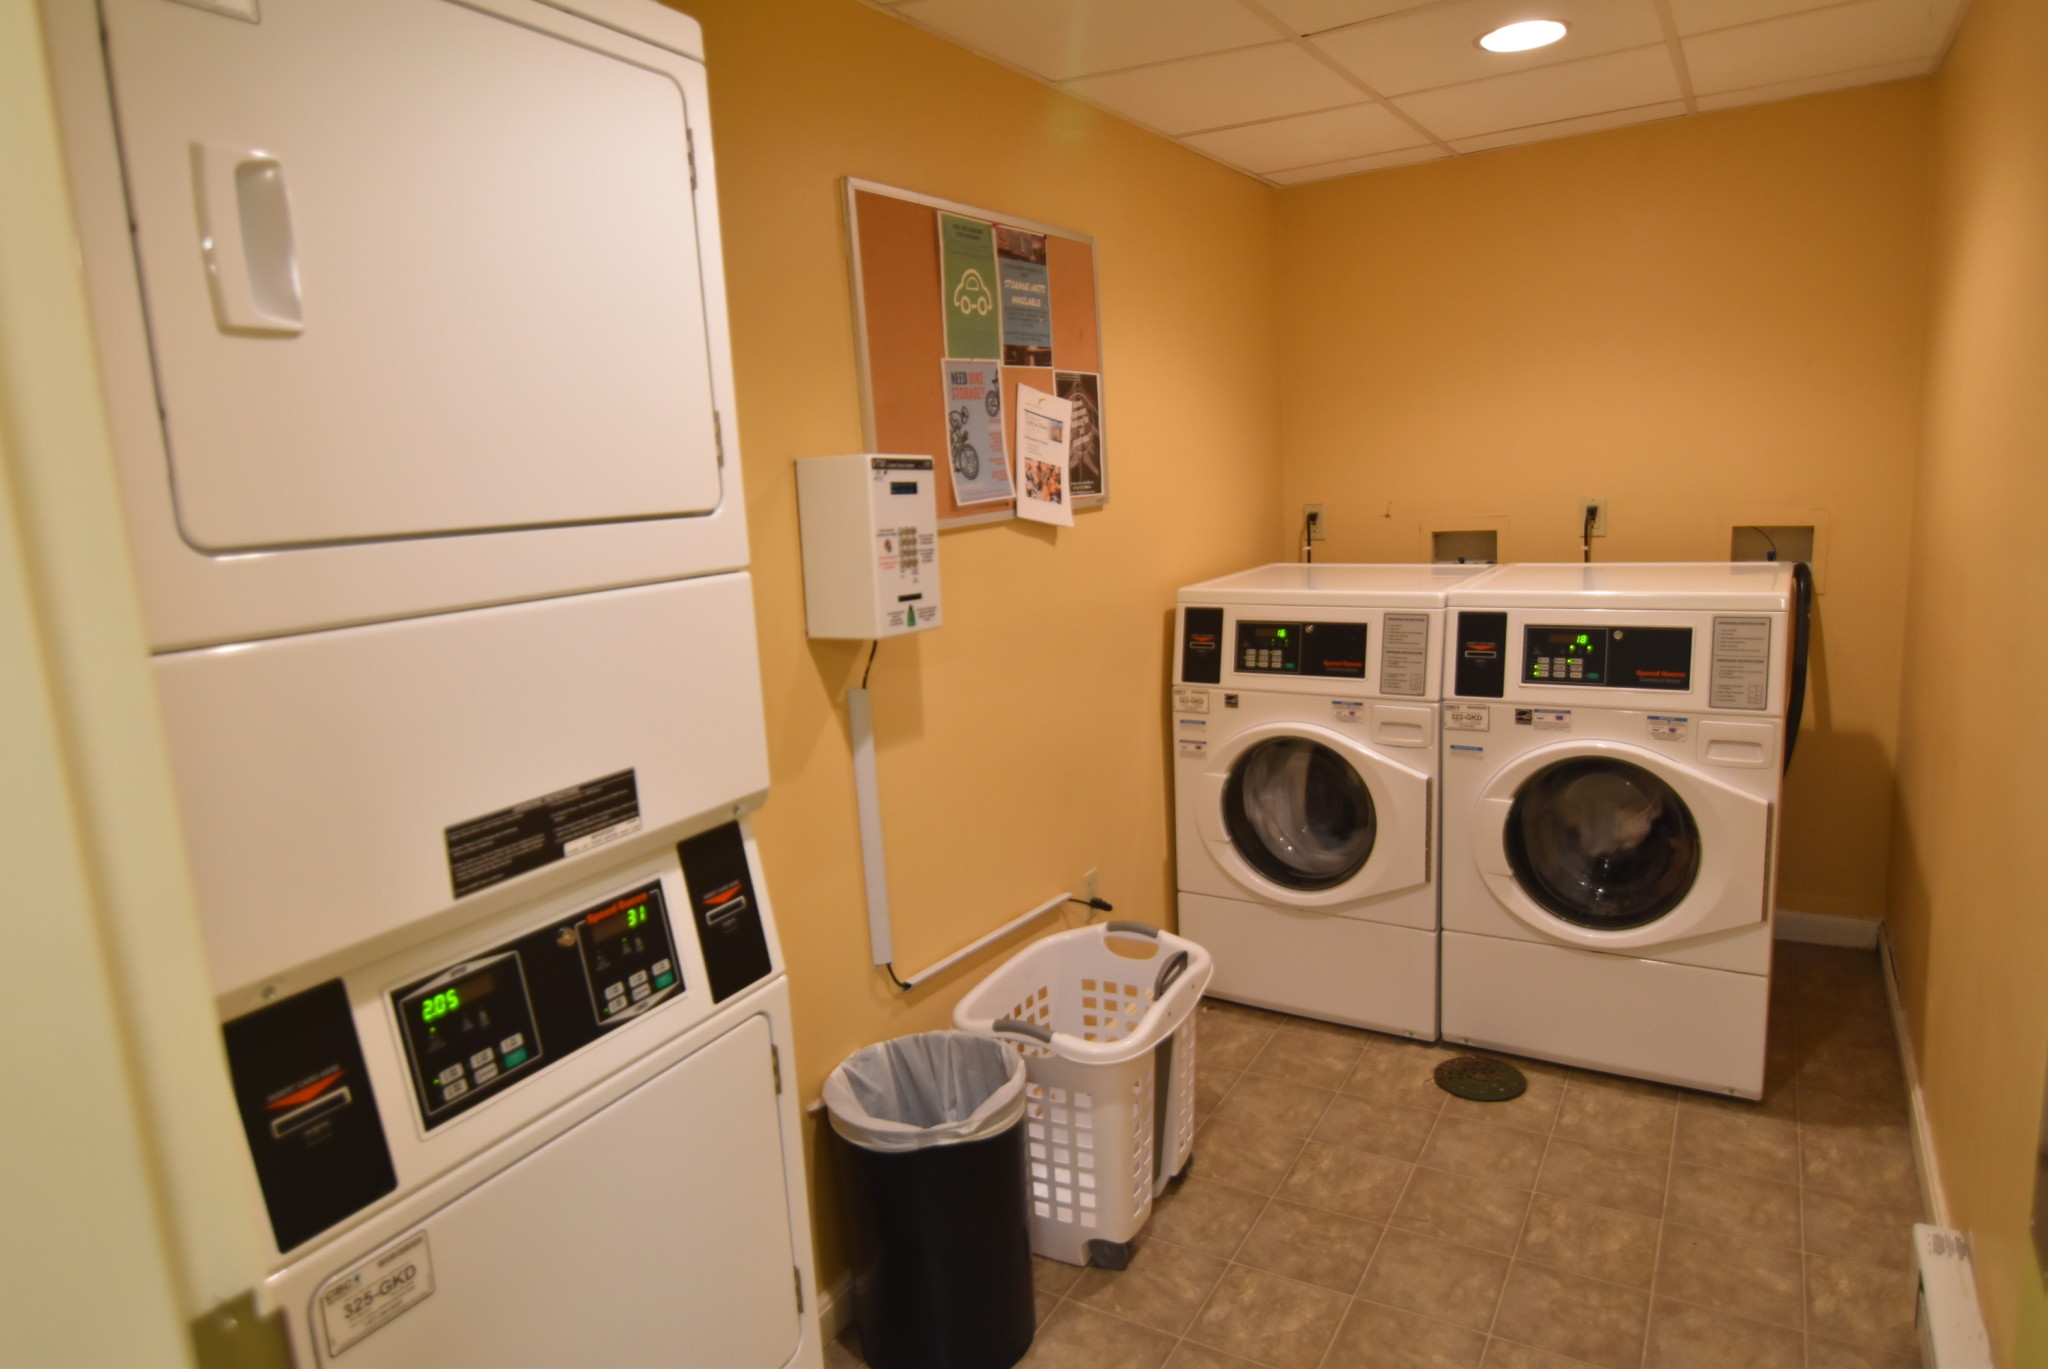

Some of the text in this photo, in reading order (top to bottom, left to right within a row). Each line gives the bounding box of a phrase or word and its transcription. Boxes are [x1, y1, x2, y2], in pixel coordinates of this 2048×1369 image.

[951, 371, 968, 386] NEED
[627, 904, 647, 928] 31
[343, 1264, 417, 1319] 325-GKD
